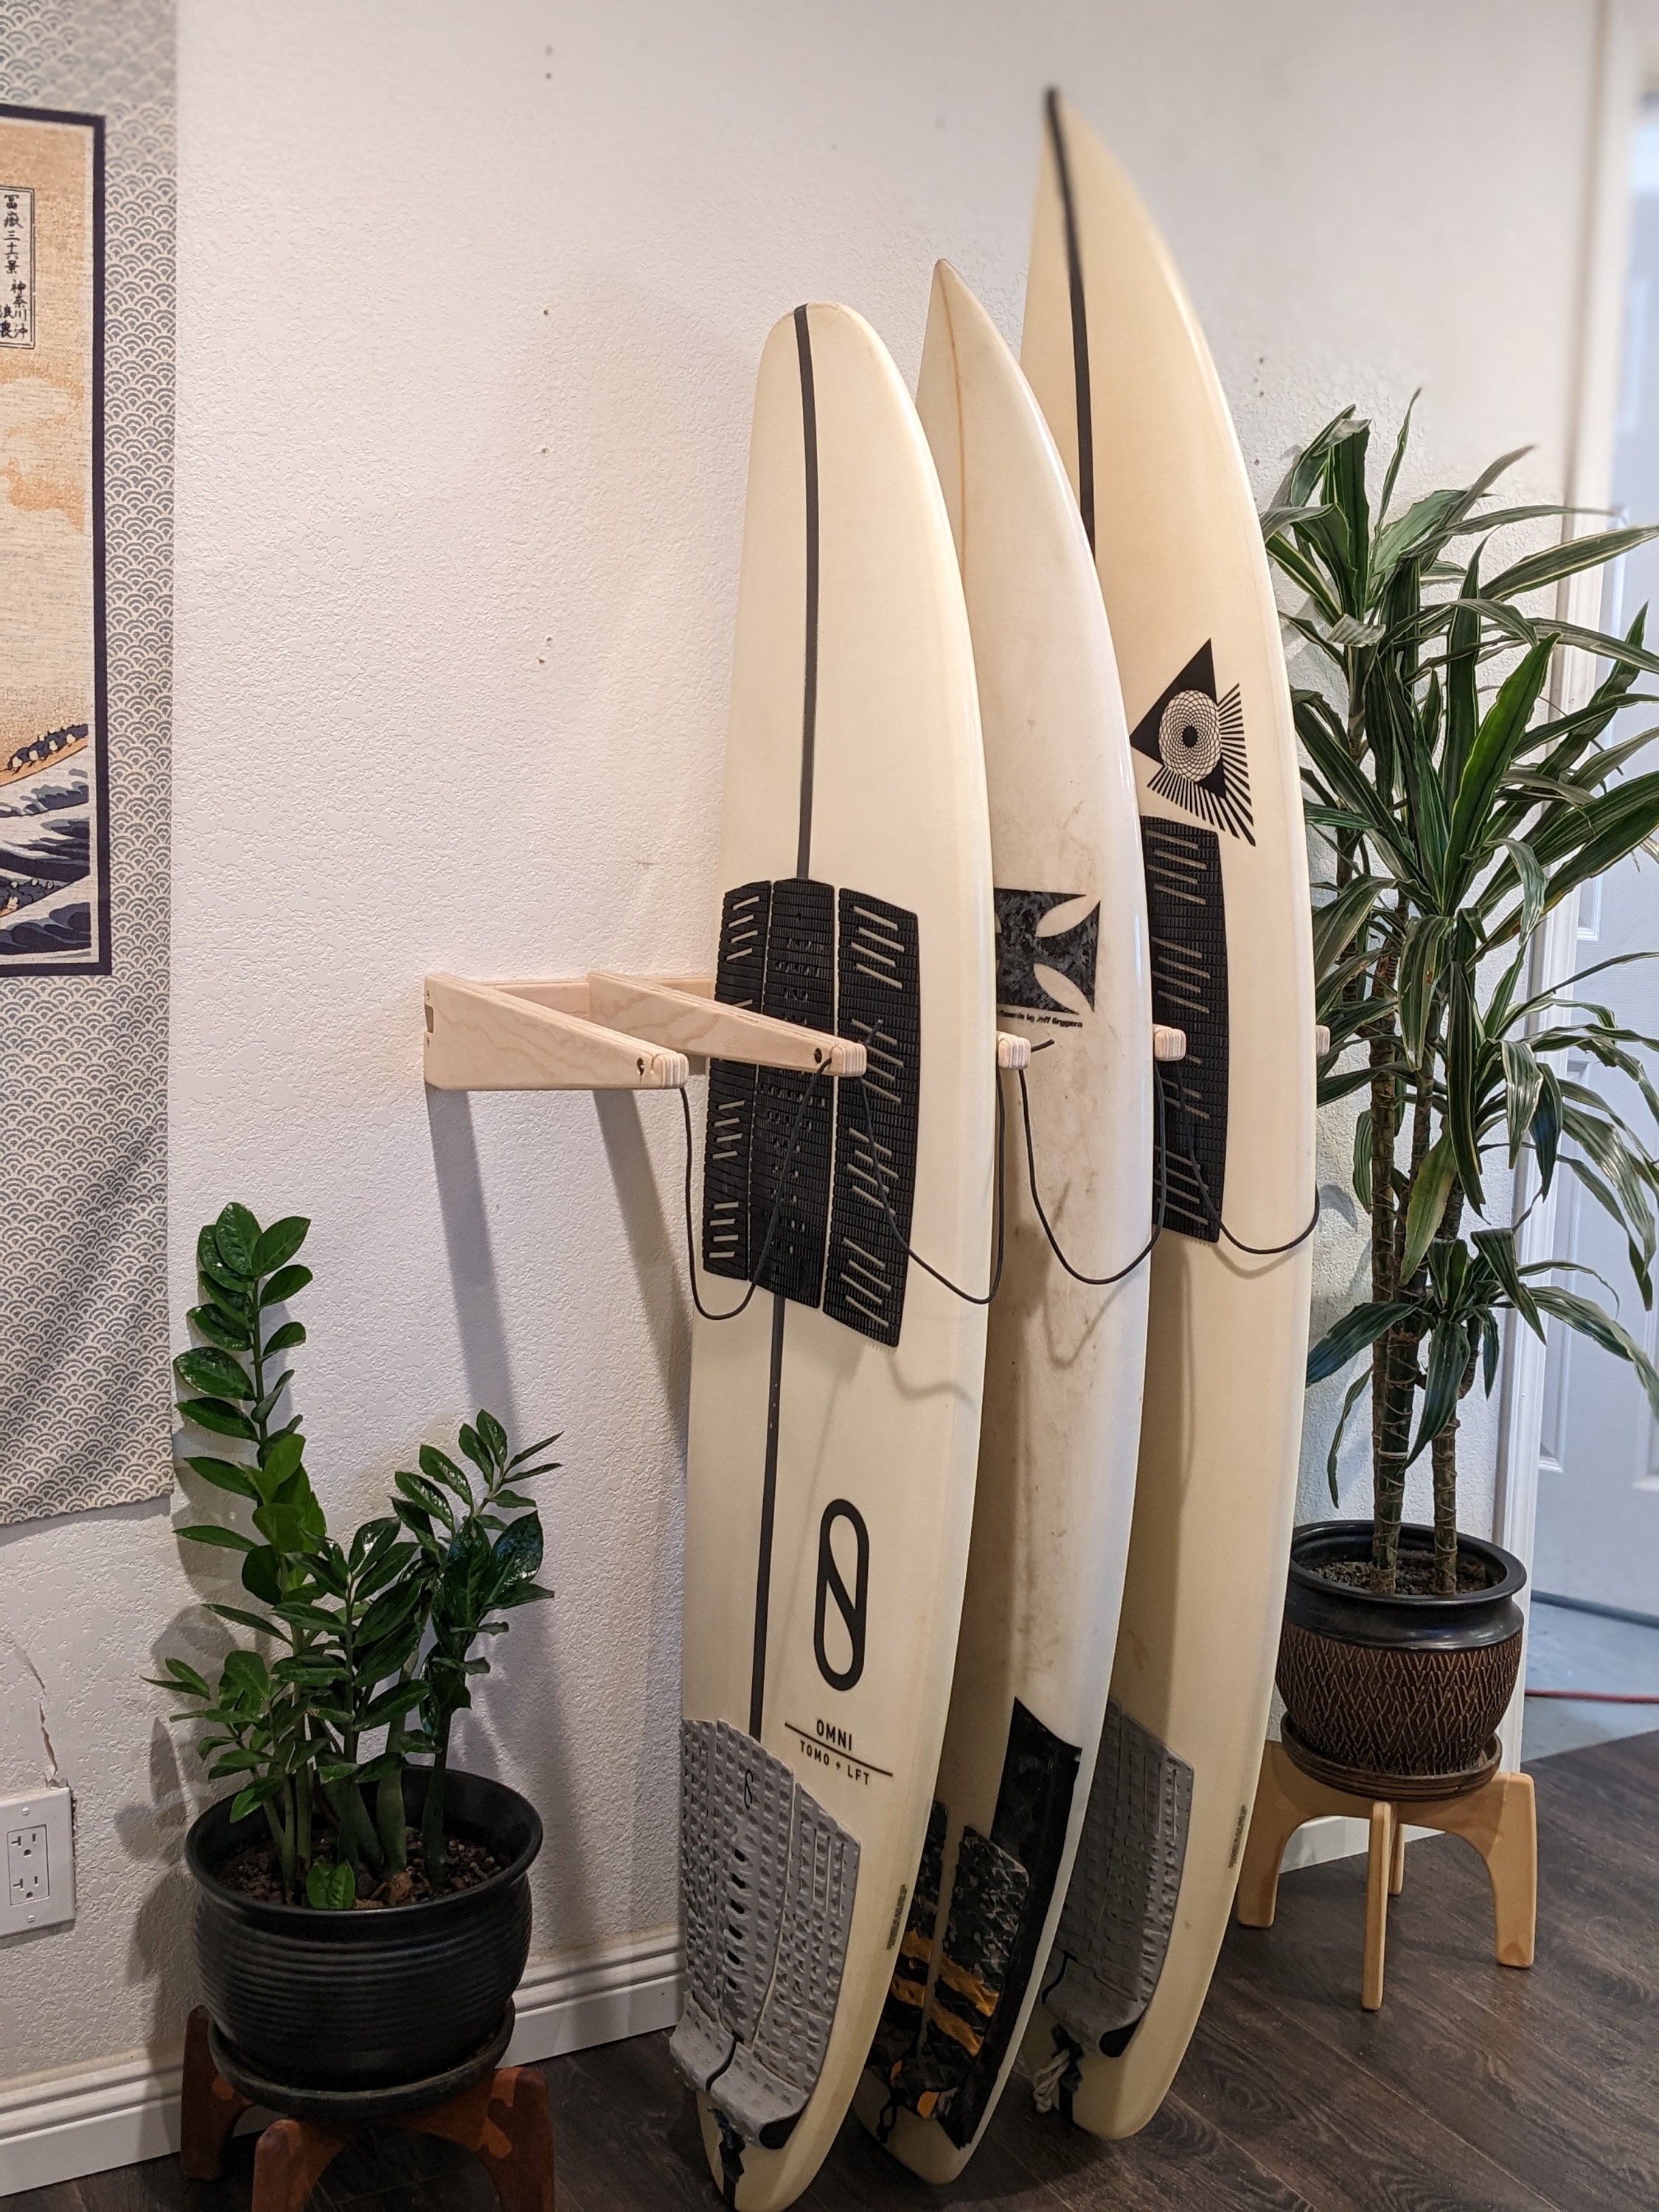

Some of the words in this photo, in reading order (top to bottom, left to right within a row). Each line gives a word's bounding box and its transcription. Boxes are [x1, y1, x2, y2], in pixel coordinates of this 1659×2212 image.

[816, 1719, 852, 1751] OMNI
[800, 1739, 830, 1766] TOMO
[847, 1764, 870, 1785] LFT
